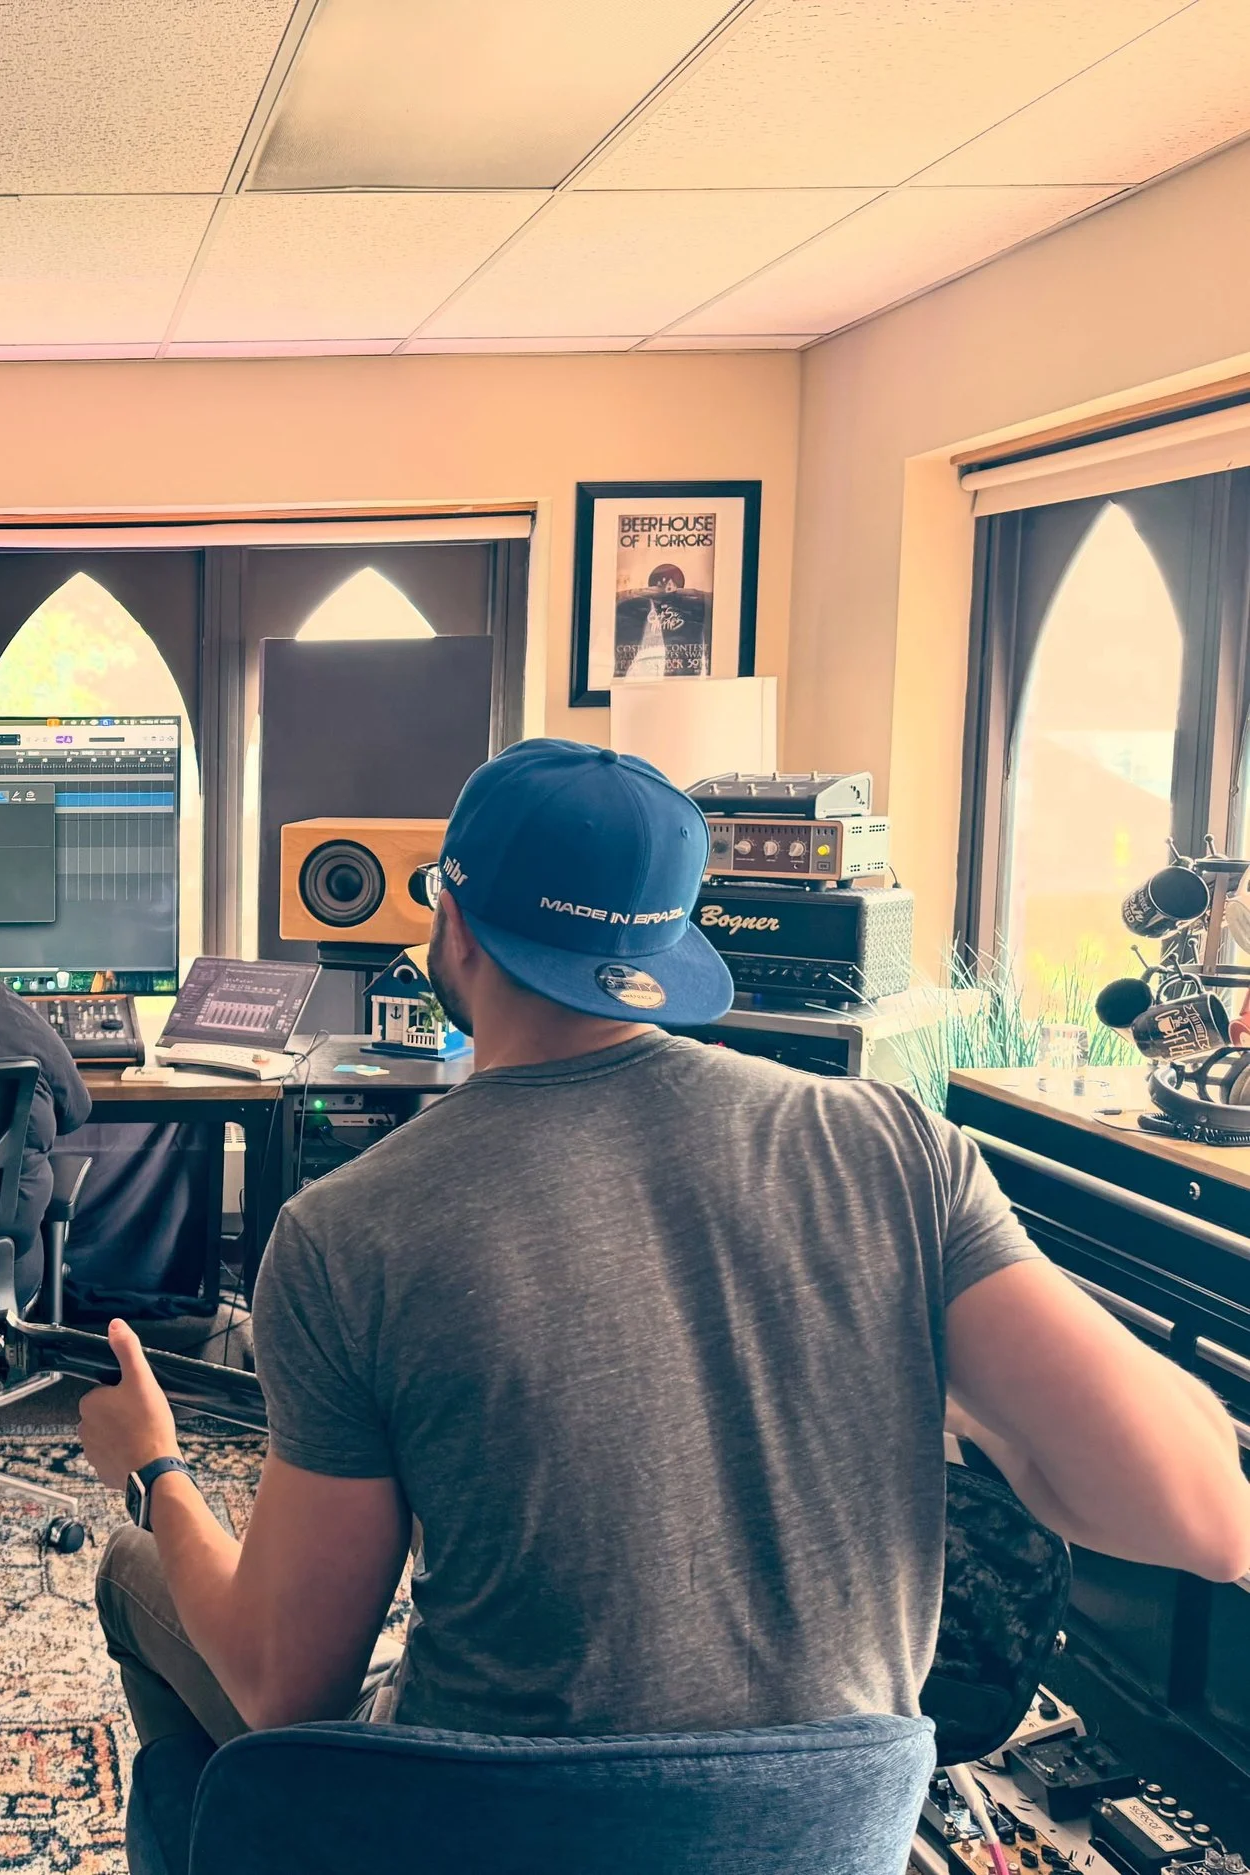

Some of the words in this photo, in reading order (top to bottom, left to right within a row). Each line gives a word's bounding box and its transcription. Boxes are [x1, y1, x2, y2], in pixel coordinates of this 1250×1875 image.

[620, 515, 713, 533] BEERHOUSE
[620, 534, 640, 548] OF
[647, 533, 713, 548] HORRORS
[540, 896, 607, 921] MADE
[610, 912, 630, 925] IN
[700, 904, 780, 935] Bogner
